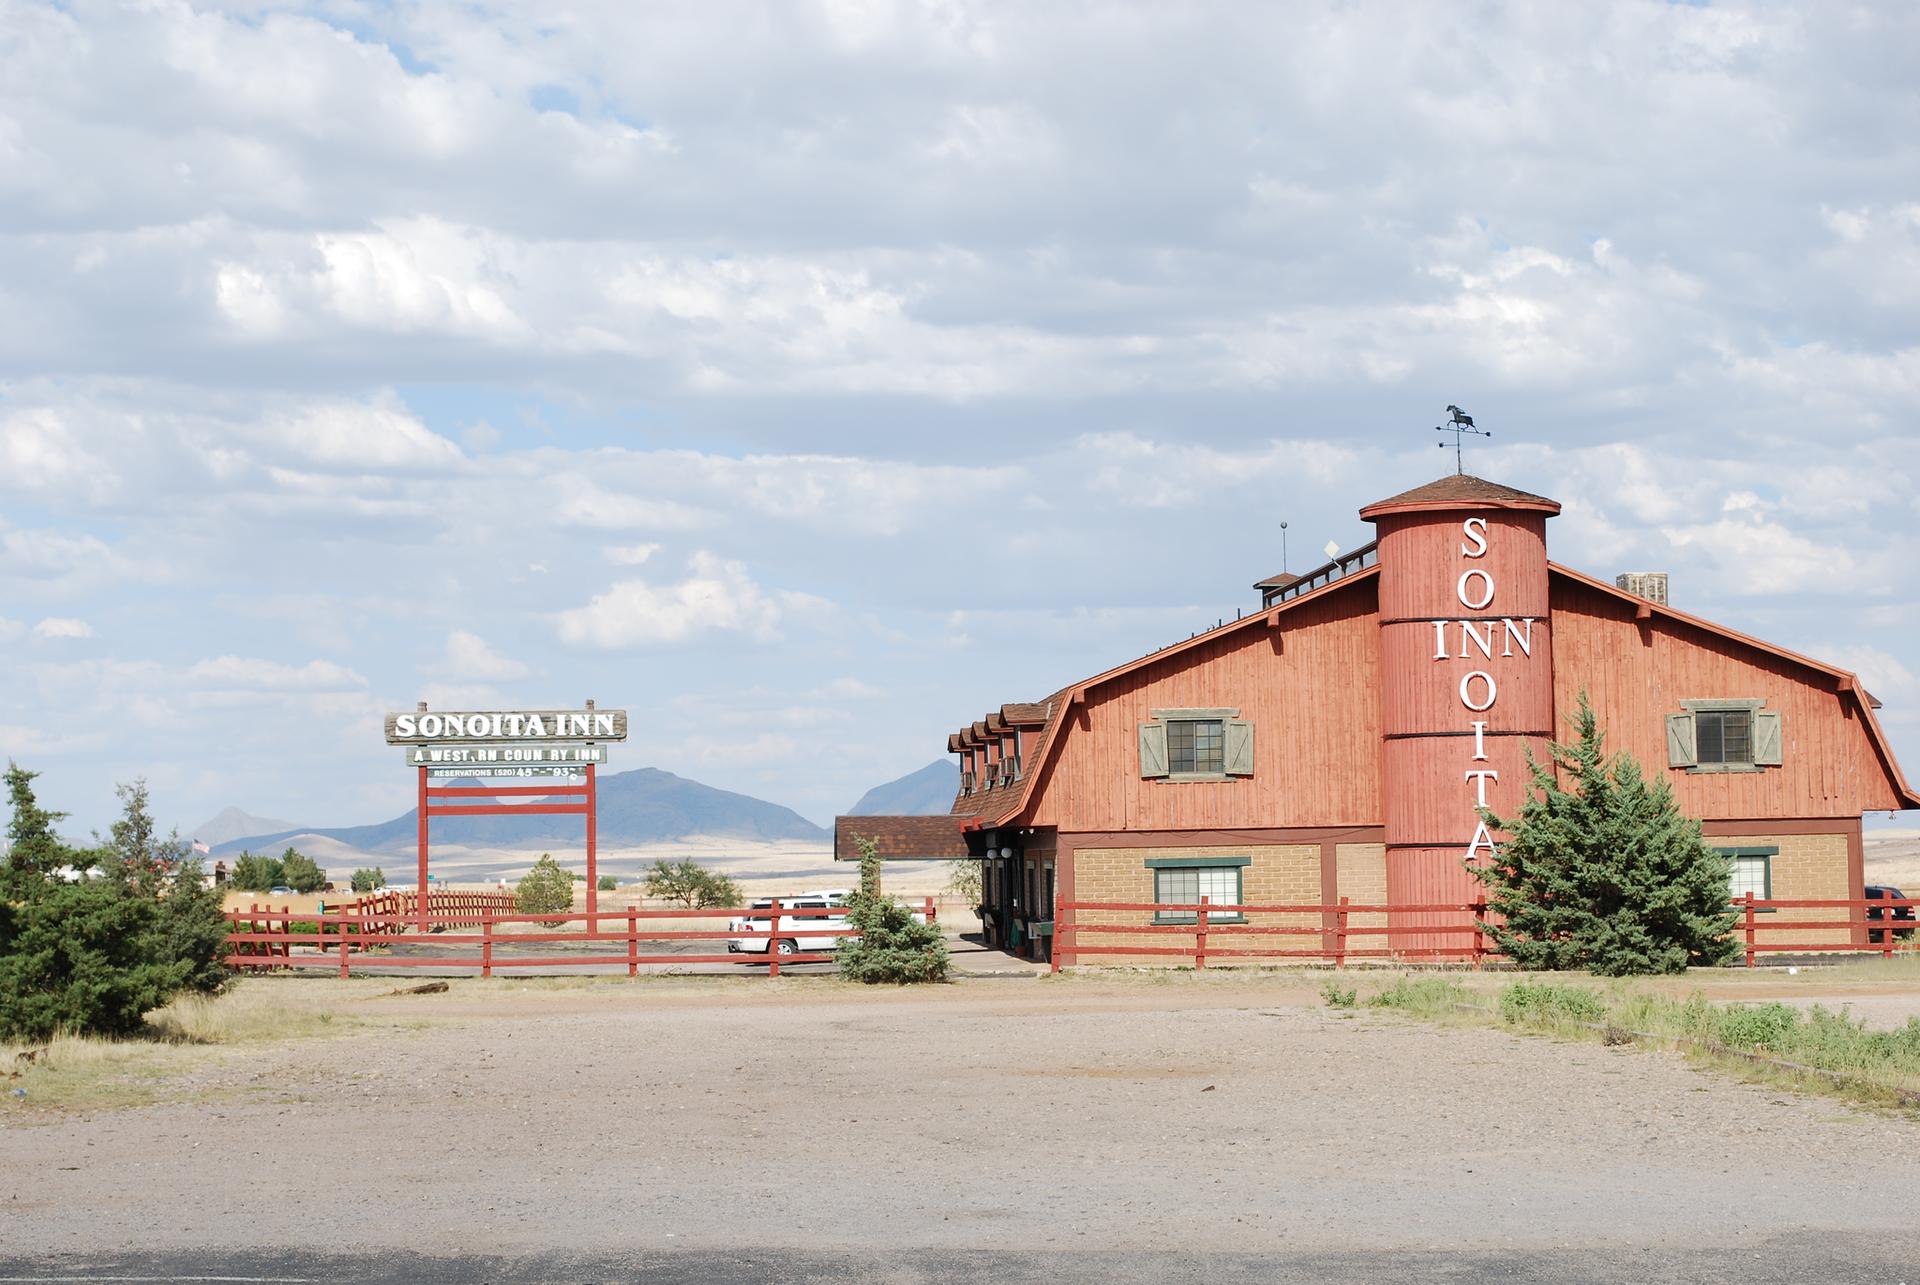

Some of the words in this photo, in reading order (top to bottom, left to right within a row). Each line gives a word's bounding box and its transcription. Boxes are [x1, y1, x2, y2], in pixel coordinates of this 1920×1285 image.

[1431, 618, 1535, 661] INN
[395, 714, 547, 738] SONOITA
[555, 713, 615, 736] INN
[414, 750, 424, 762] A
[430, 749, 498, 763] WESTRN
[504, 749, 568, 761] COUNRY
[575, 749, 600, 761] INN
[434, 769, 492, 777] RESERVATIONS
